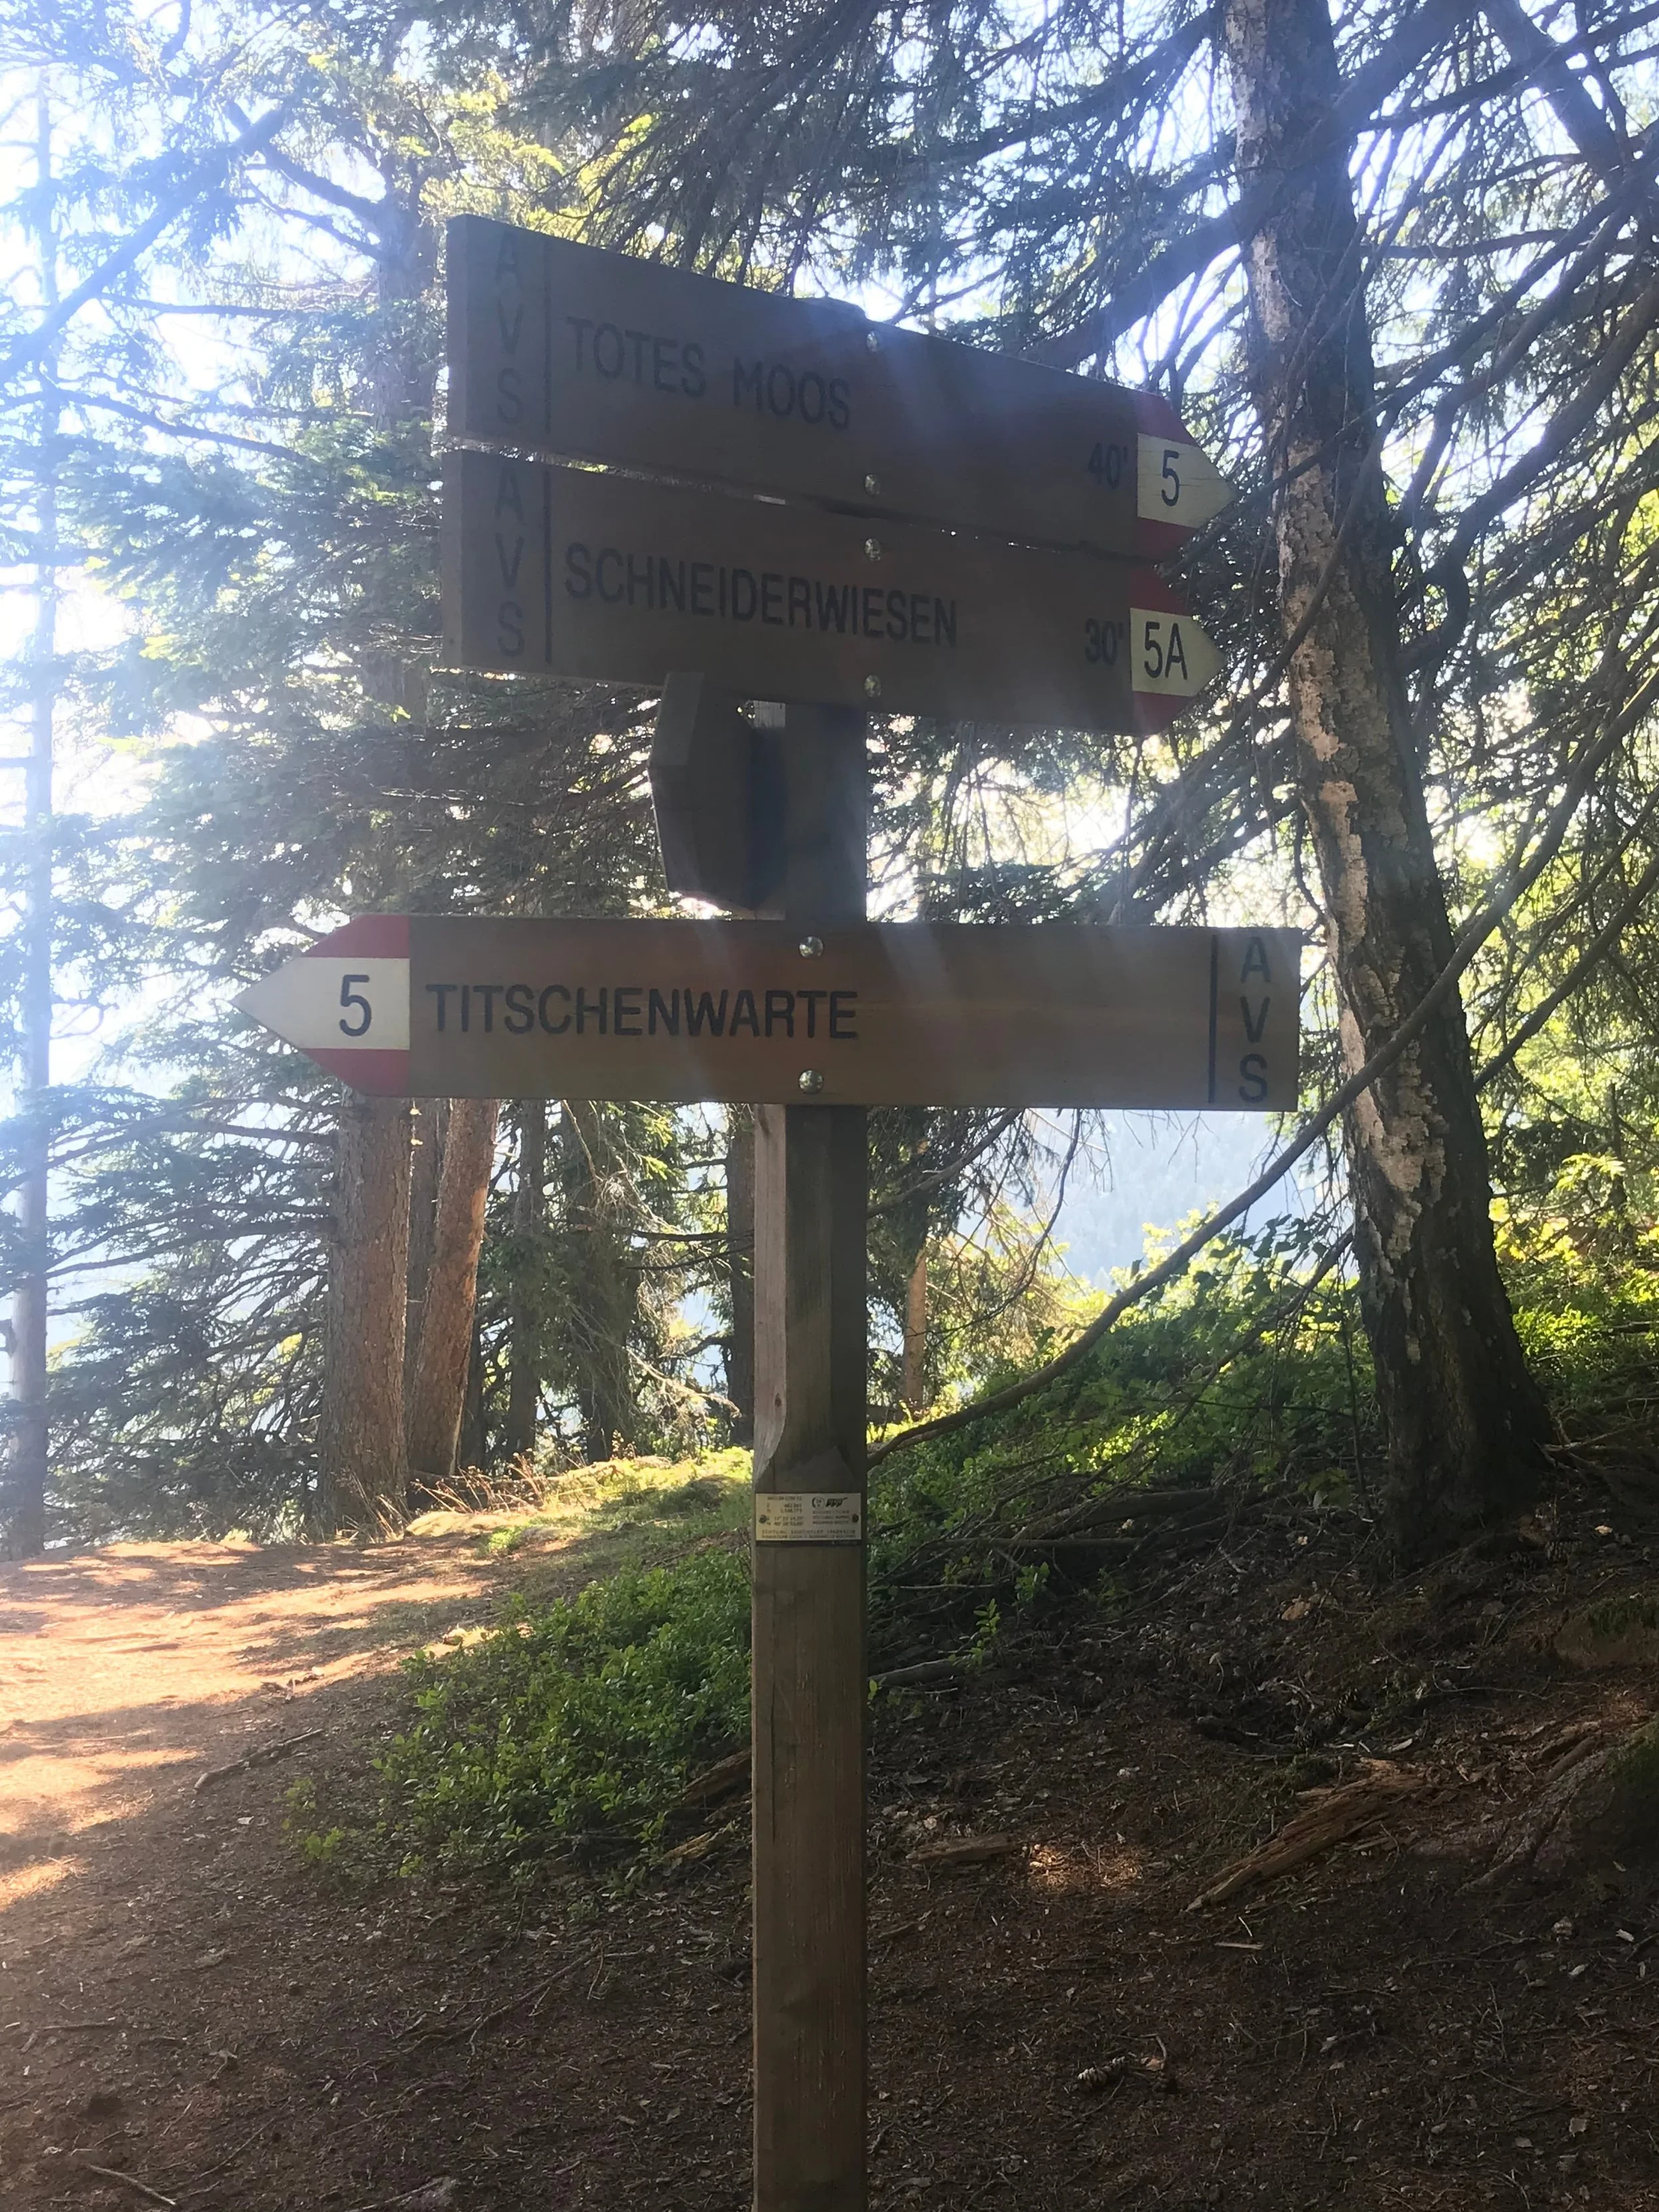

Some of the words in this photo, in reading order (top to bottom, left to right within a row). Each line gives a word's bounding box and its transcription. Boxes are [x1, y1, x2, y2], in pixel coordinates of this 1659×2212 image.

[565, 315, 707, 398] TOTES
[733, 356, 851, 431] MOOS
[1160, 449, 1180, 507] 5
[564, 542, 958, 648] SCHNEIDERWIESEN
[1143, 621, 1189, 681] 5A
[339, 974, 373, 1038] 5
[425, 982, 860, 1041] TITSCHENWARTE
